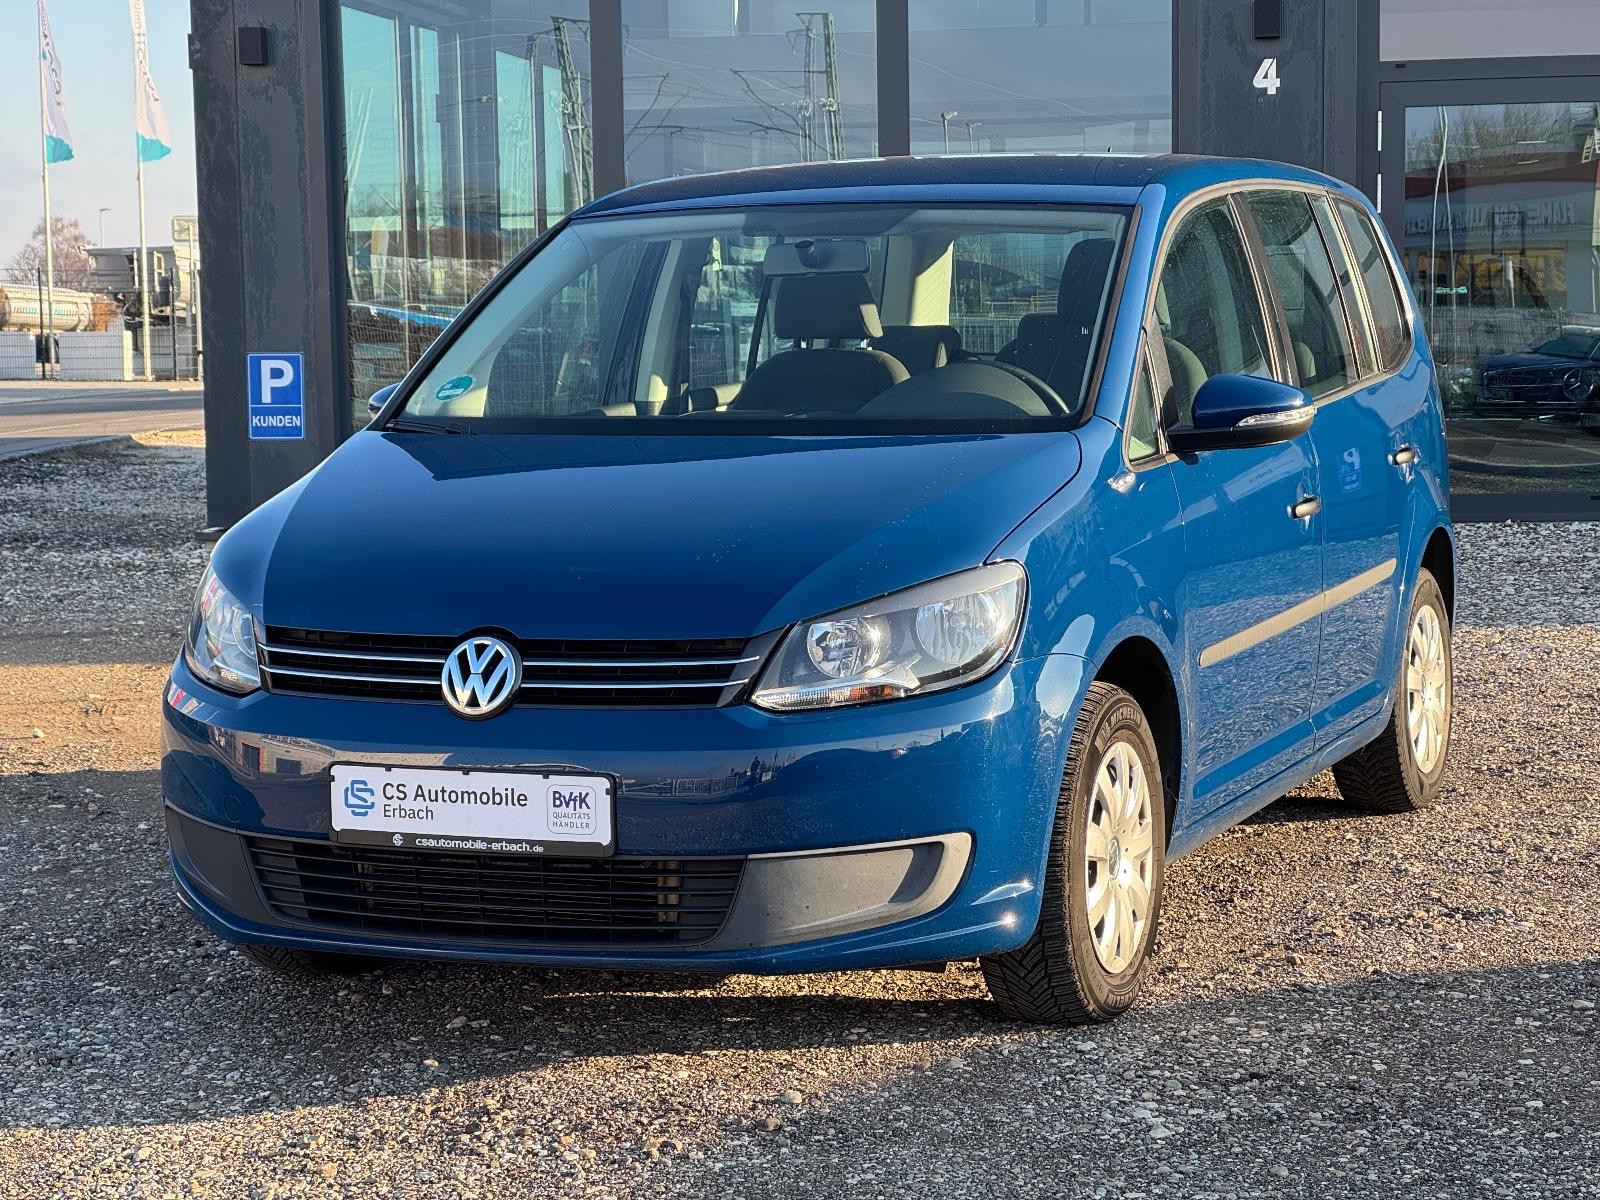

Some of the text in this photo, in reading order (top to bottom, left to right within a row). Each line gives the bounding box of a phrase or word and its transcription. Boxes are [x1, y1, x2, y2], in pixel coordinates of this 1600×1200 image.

[1253, 58, 1280, 94] 4
[261, 360, 294, 403] P
[252, 416, 301, 427] KUNDEN
[382, 782, 528, 807] CS Automobile
[552, 790, 591, 811] BVfK
[383, 804, 434, 820] Erbach
[552, 810, 591, 820] QUALITÄTS
[552, 819, 591, 829] HÄNDLER
[415, 837, 544, 852] csautomobile-erbach.de
